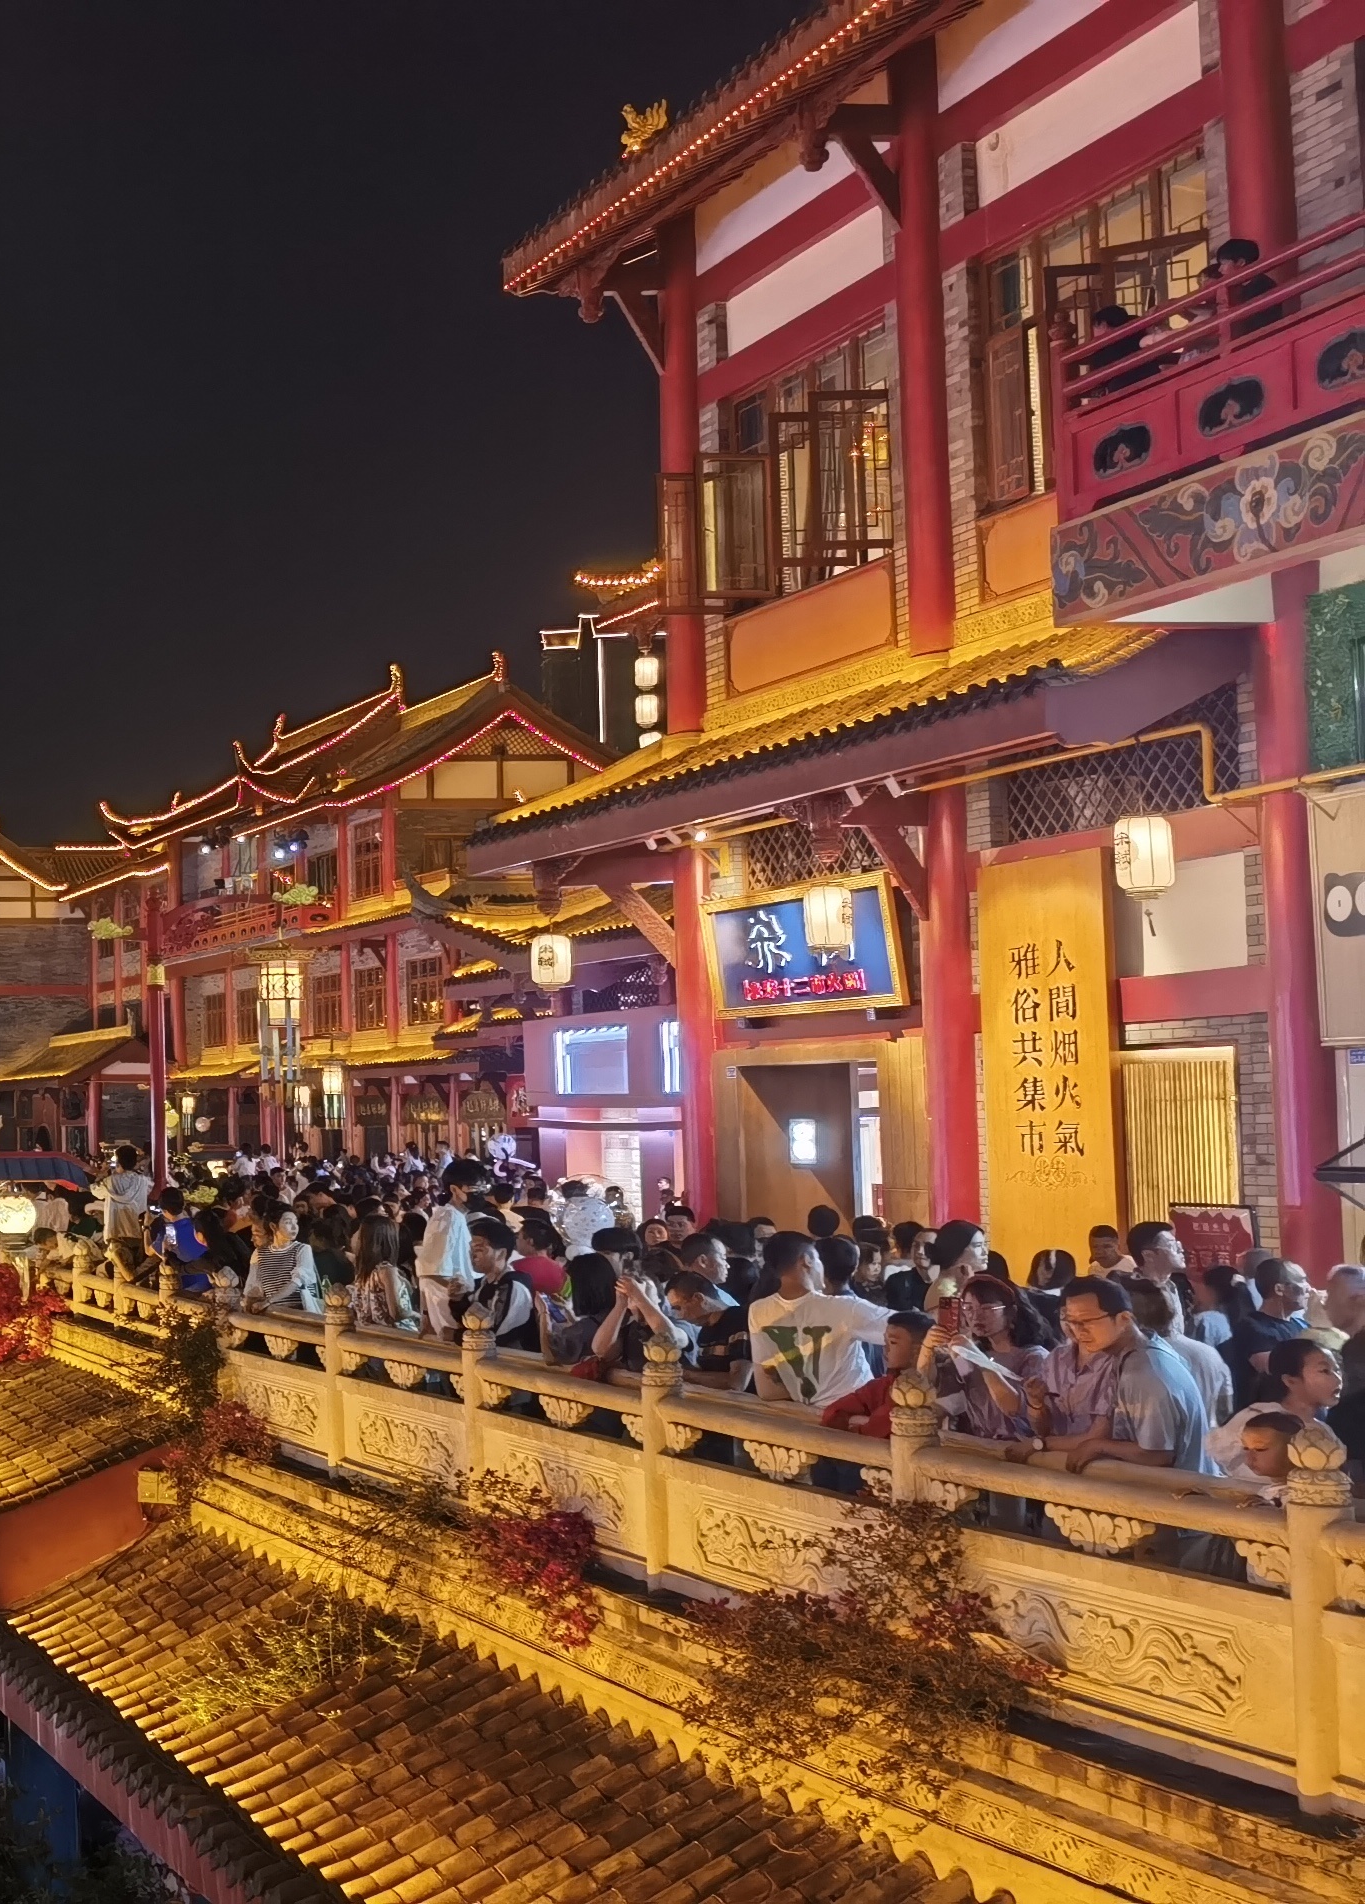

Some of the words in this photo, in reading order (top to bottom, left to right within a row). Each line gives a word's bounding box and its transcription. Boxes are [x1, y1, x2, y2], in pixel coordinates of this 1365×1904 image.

[1008, 943, 1046, 1157] 雅俗共集市
[1046, 939, 1085, 1157] 人間烟火氣
